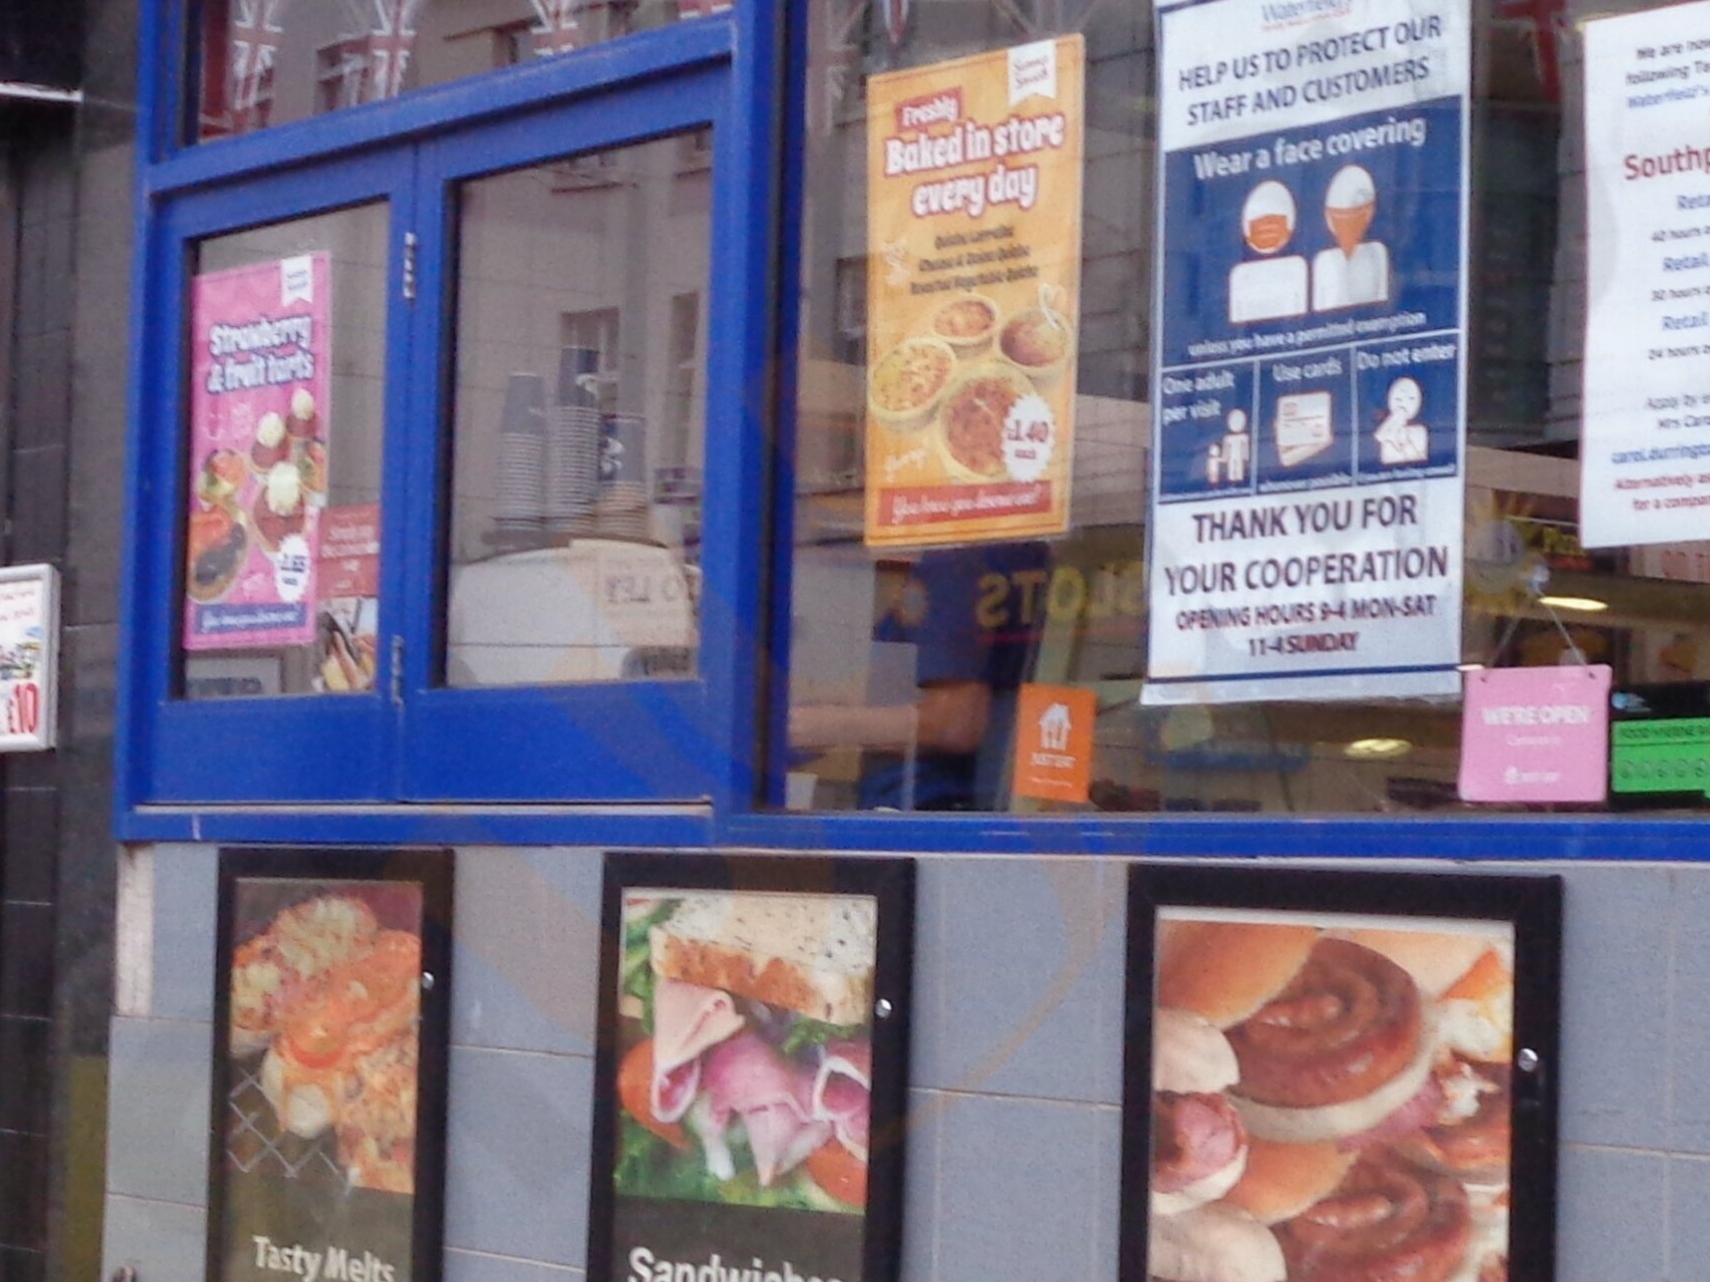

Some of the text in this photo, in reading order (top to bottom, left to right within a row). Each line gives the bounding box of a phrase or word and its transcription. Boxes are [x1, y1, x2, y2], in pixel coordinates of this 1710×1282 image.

[1179, 15, 1443, 92] HELP US TO PROTECT OUR
[900, 94, 960, 127] Freshly
[1186, 55, 1431, 126] STAFF AND CUSTOMERS
[885, 114, 1065, 176] Baked in store
[1193, 114, 1429, 180] Wear a face covering
[912, 163, 1038, 218] every day
[1662, 252, 1710, 272] Retail
[208, 315, 312, 357] Strawberry
[1661, 311, 1710, 331] Retail
[222, 352, 267, 392] fruit
[267, 349, 315, 385] tarts
[1271, 355, 1343, 383] Use cards
[1357, 351, 1380, 371] Do
[1162, 369, 1235, 396] One adult
[1191, 493, 1418, 544] THANK YOU FOR
[1164, 545, 1449, 597] YOUR COOPERATION
[1174, 593, 1437, 632] OPENING HOURS 9-4 MON-SAT
[1248, 630, 1360, 658] 11-4 SUNDAY
